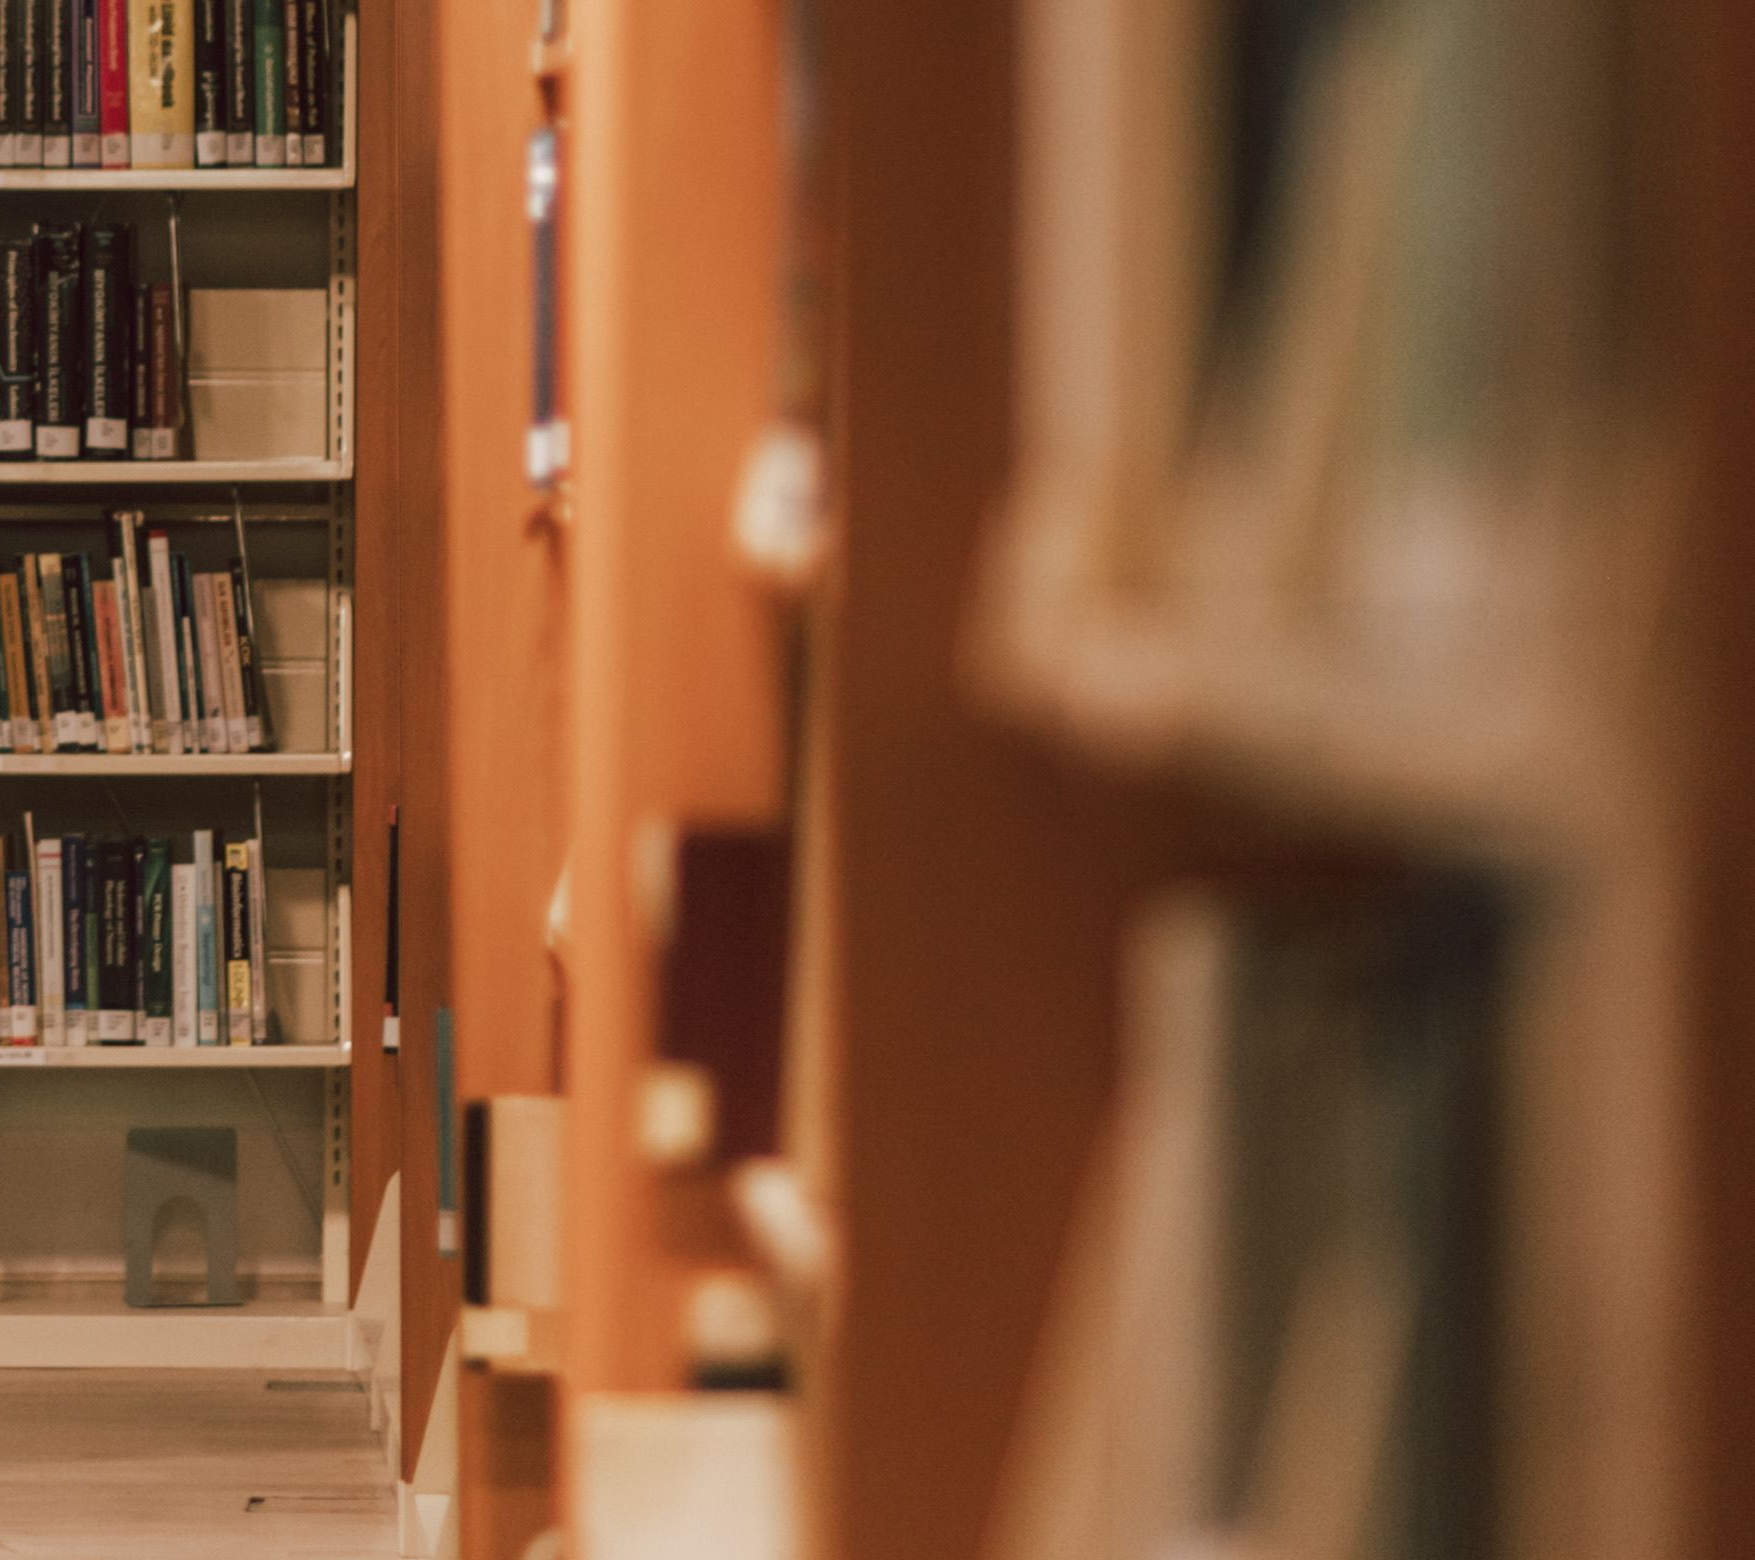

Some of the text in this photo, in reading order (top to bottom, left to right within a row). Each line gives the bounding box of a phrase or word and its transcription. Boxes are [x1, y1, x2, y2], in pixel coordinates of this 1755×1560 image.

[7, 250, 19, 298] Principles
[8, 310, 19, 372] Biochemistry
[229, 872, 245, 958] Bioinformatics
